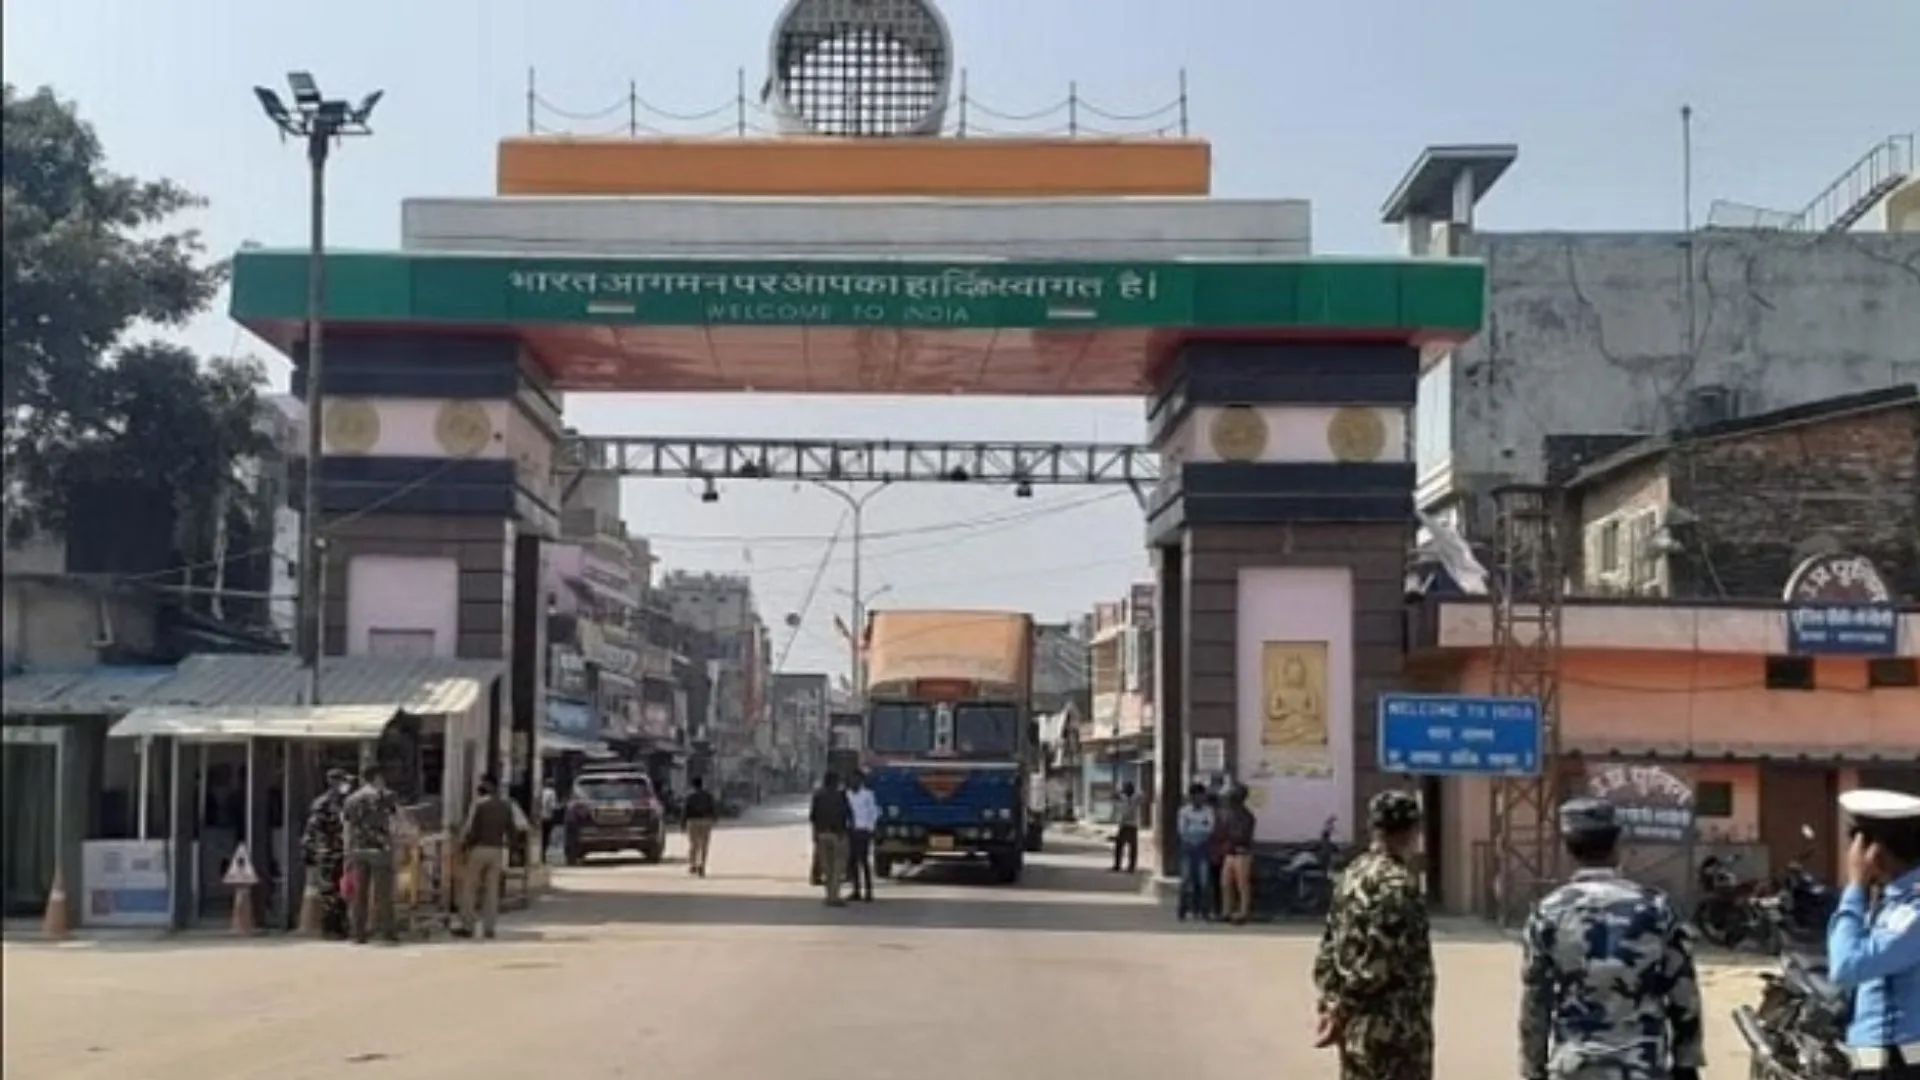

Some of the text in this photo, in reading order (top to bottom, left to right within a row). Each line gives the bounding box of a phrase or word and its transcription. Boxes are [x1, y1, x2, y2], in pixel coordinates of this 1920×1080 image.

[508, 271, 597, 294] भारत
[601, 271, 728, 295] आगमन
[732, 271, 781, 296] पर
[781, 272, 899, 297] आपका
[706, 303, 970, 322] WELCOME TO INDIA
[1388, 701, 1533, 721] WELCOME TO INDIA
